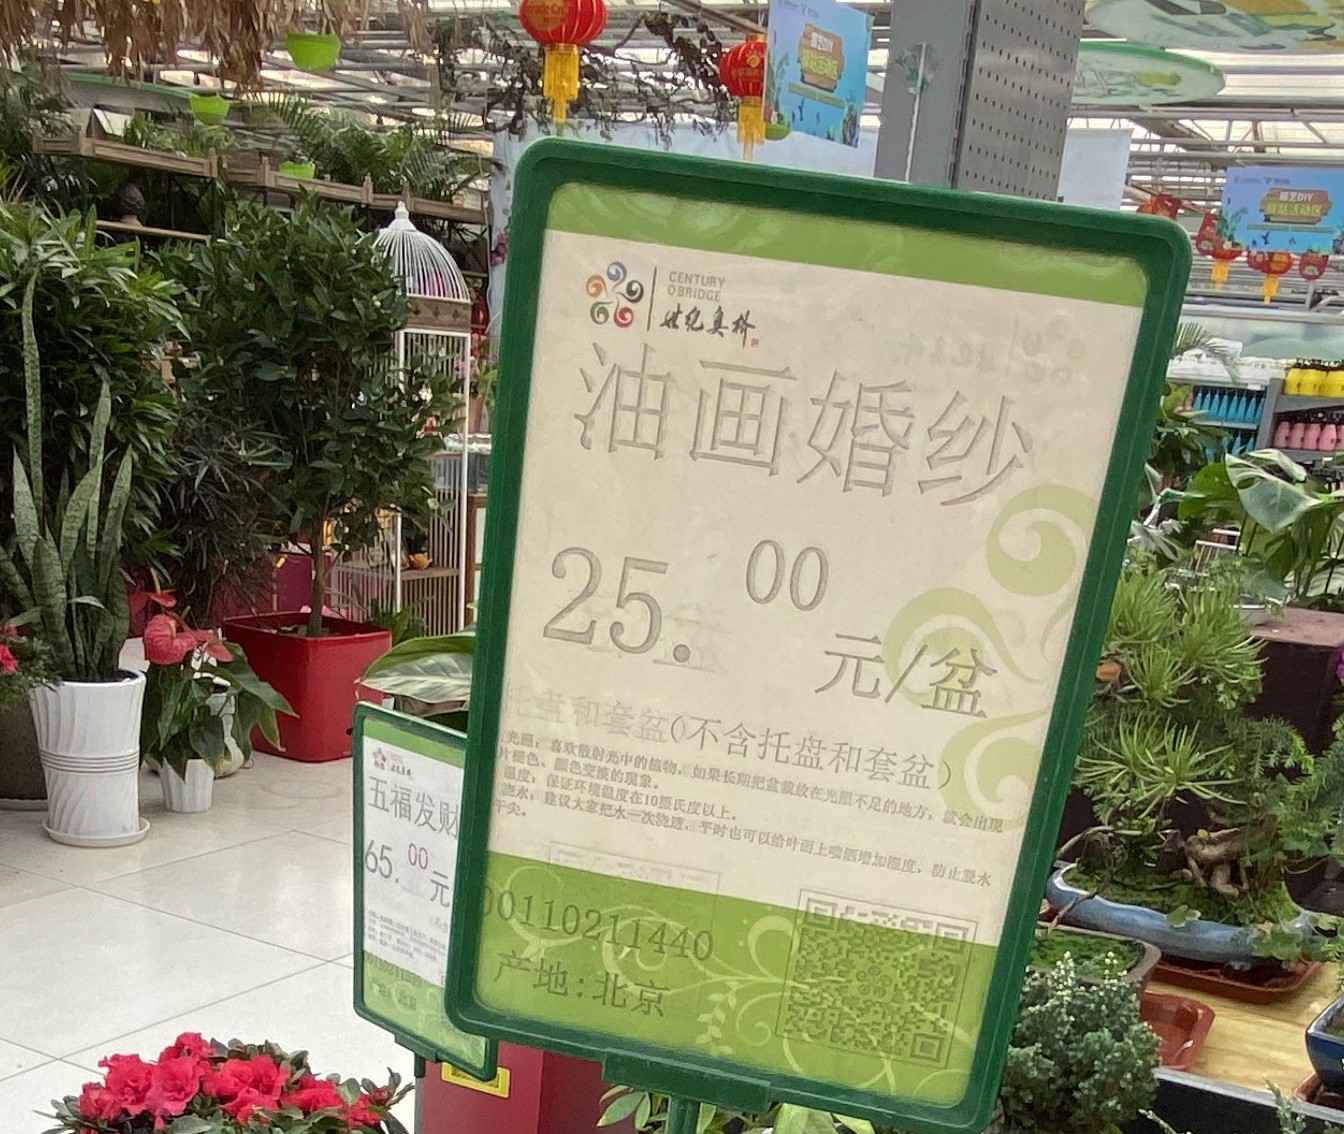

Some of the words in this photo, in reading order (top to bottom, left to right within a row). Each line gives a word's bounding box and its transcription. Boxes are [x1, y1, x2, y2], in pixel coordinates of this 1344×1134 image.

[668, 271, 726, 289] CENTURY
[574, 342, 1034, 507] 油画婚纱
[745, 538, 830, 613] 00
[814, 632, 1000, 720] 元/盆
[670, 713, 951, 791] (不含托盘和套盆)
[367, 775, 459, 840] 五福发财
[407, 842, 430, 871] 00
[493, 949, 672, 1018] 产地:北京
